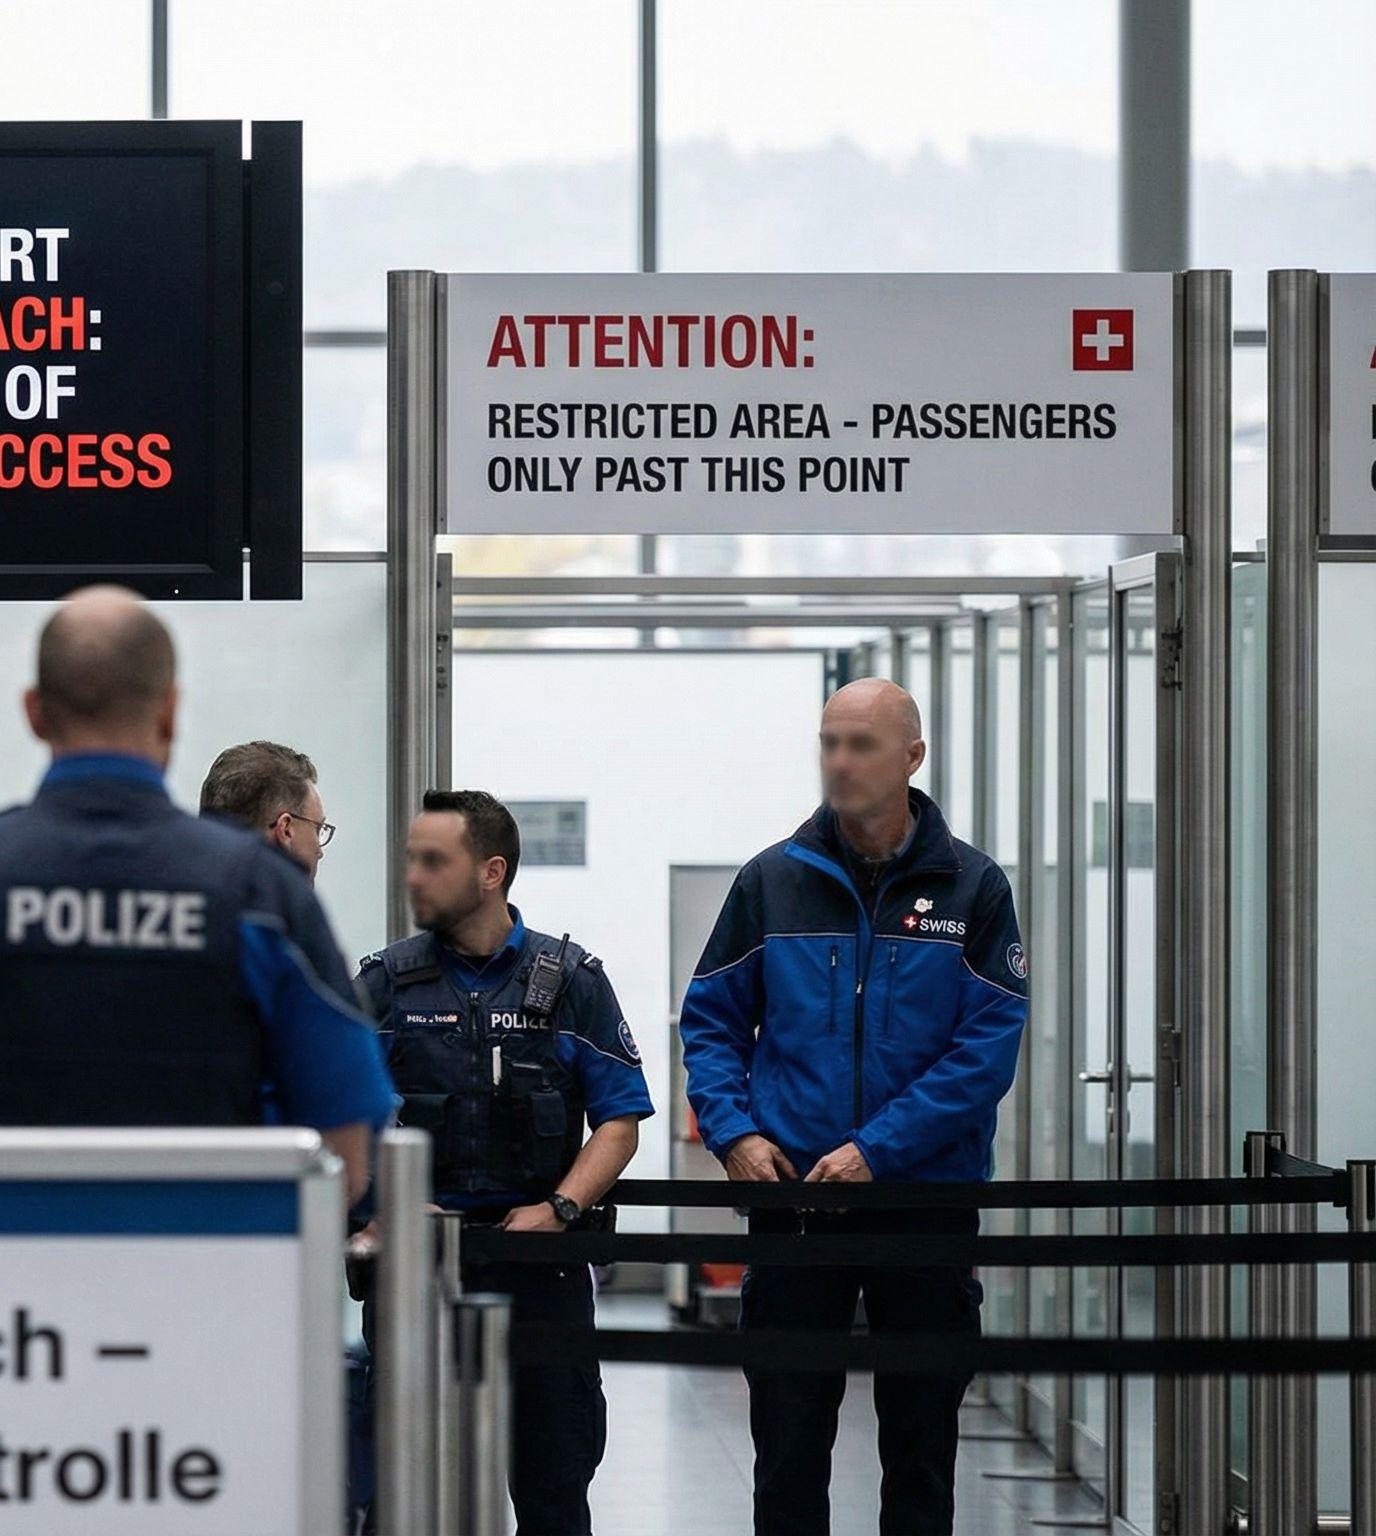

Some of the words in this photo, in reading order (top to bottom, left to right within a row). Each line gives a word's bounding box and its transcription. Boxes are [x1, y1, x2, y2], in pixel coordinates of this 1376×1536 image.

[486, 313, 815, 369] ATTENTION:
[5, 364, 77, 420] OF
[488, 402, 718, 440] RESTRICTED
[729, 403, 831, 440] AREA
[872, 402, 1117, 440] PASSENGERS
[487, 456, 583, 493] ONLY
[595, 456, 690, 493] PAST
[700, 456, 786, 493] THIS
[799, 456, 910, 493] POINT
[6, 886, 207, 951] POLIZE
[919, 918, 966, 935] SWISS
